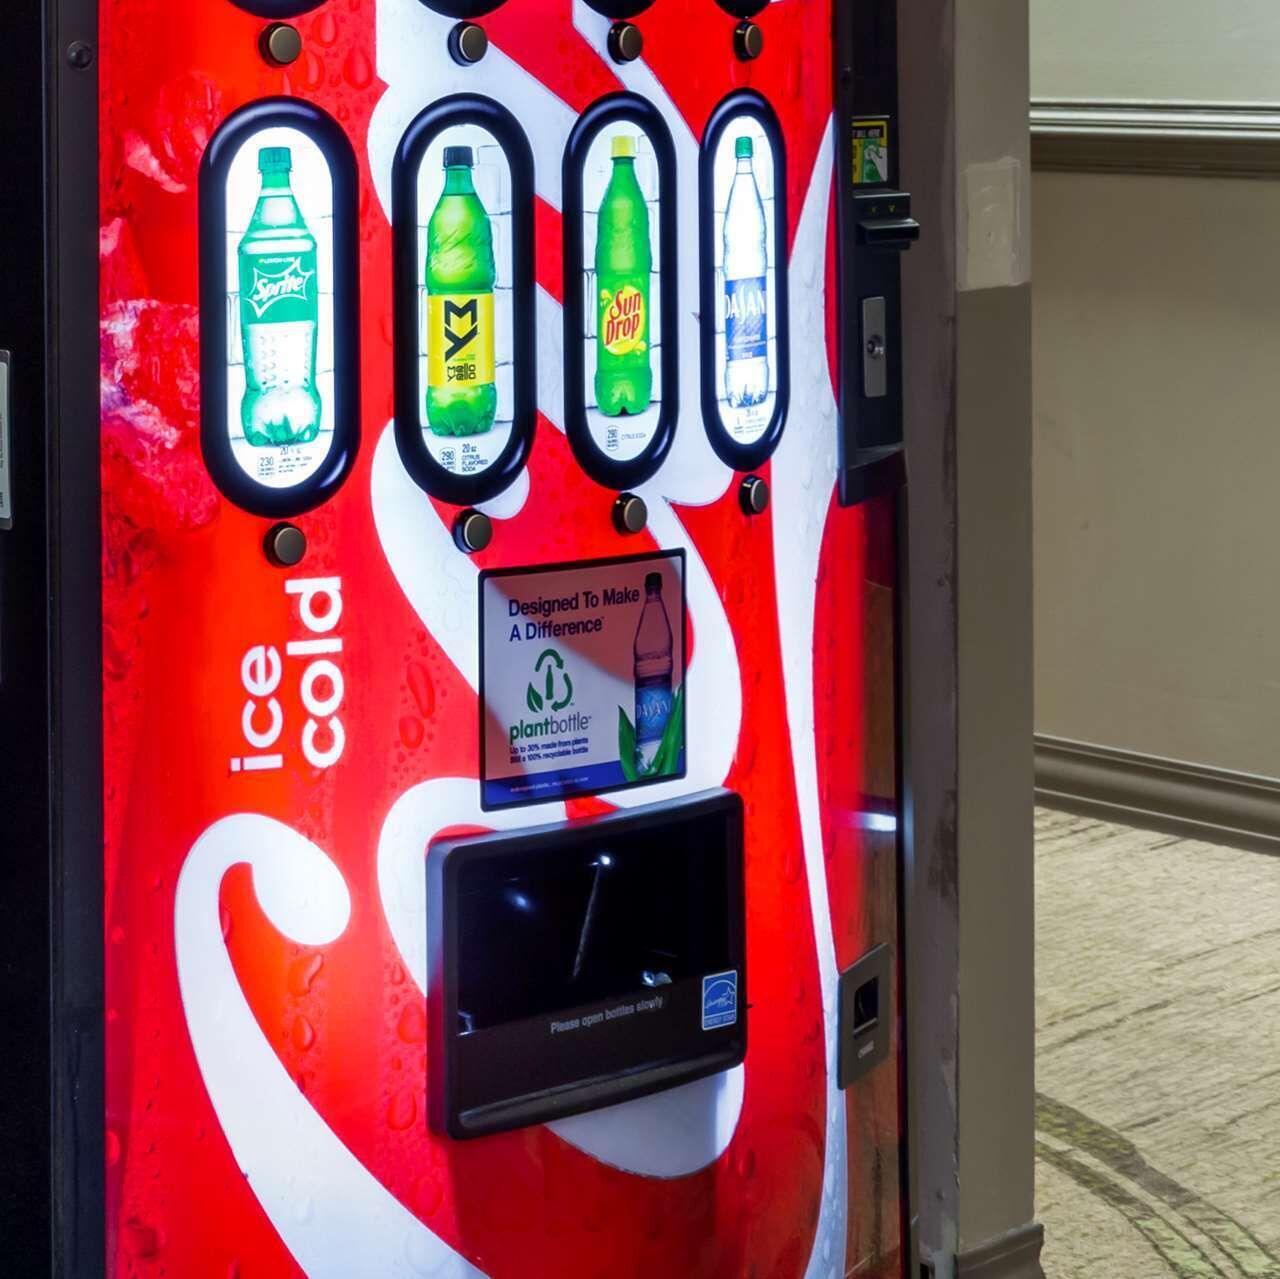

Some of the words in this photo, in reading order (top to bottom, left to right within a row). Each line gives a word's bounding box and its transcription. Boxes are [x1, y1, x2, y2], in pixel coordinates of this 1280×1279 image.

[252, 275, 305, 302] Sprite
[610, 286, 641, 321] Sun
[605, 312, 639, 346] Drop
[509, 593, 579, 617] Designed
[583, 591, 599, 608] To
[603, 587, 639, 606] Make
[510, 624, 521, 641] A
[526, 618, 602, 639] Difference
[285, 576, 345, 768] cold
[230, 645, 283, 772] ice
[510, 712, 588, 745] plantbottle
[551, 1020, 579, 1034] Please
[582, 1013, 603, 1026] open
[605, 1005, 635, 1021] bottles
[637, 996, 663, 1012] slowly
